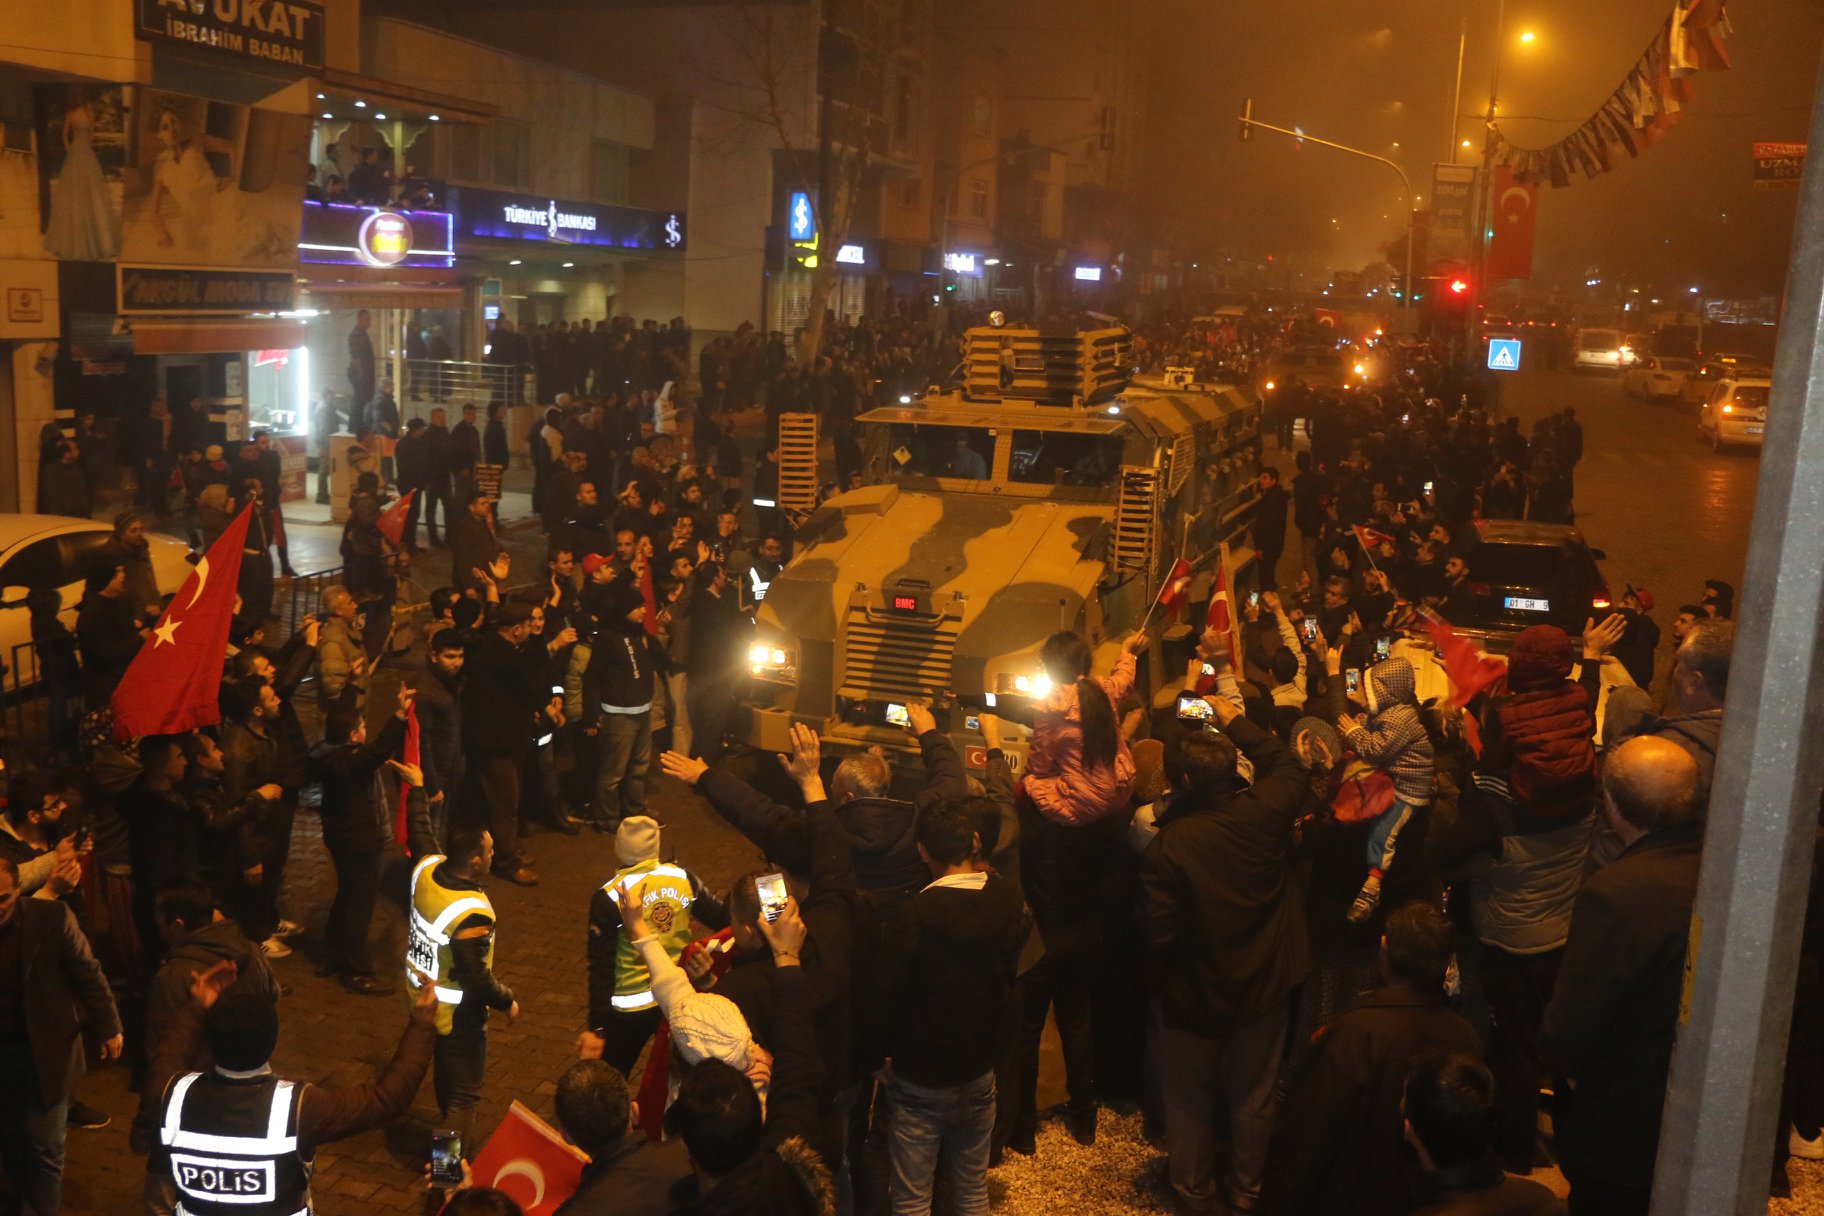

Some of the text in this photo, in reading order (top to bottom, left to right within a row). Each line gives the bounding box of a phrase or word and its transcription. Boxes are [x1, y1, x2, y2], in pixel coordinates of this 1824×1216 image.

[166, 13, 303, 65] İBRAHİM BABAN
[503, 204, 548, 227] TÜRKİYE
[556, 212, 597, 231] BANKASI
[895, 597, 915, 609] BMC
[1509, 598, 1518, 607] 01
[1525, 600, 1535, 609] GH
[183, 1166, 261, 1192] POLiS
